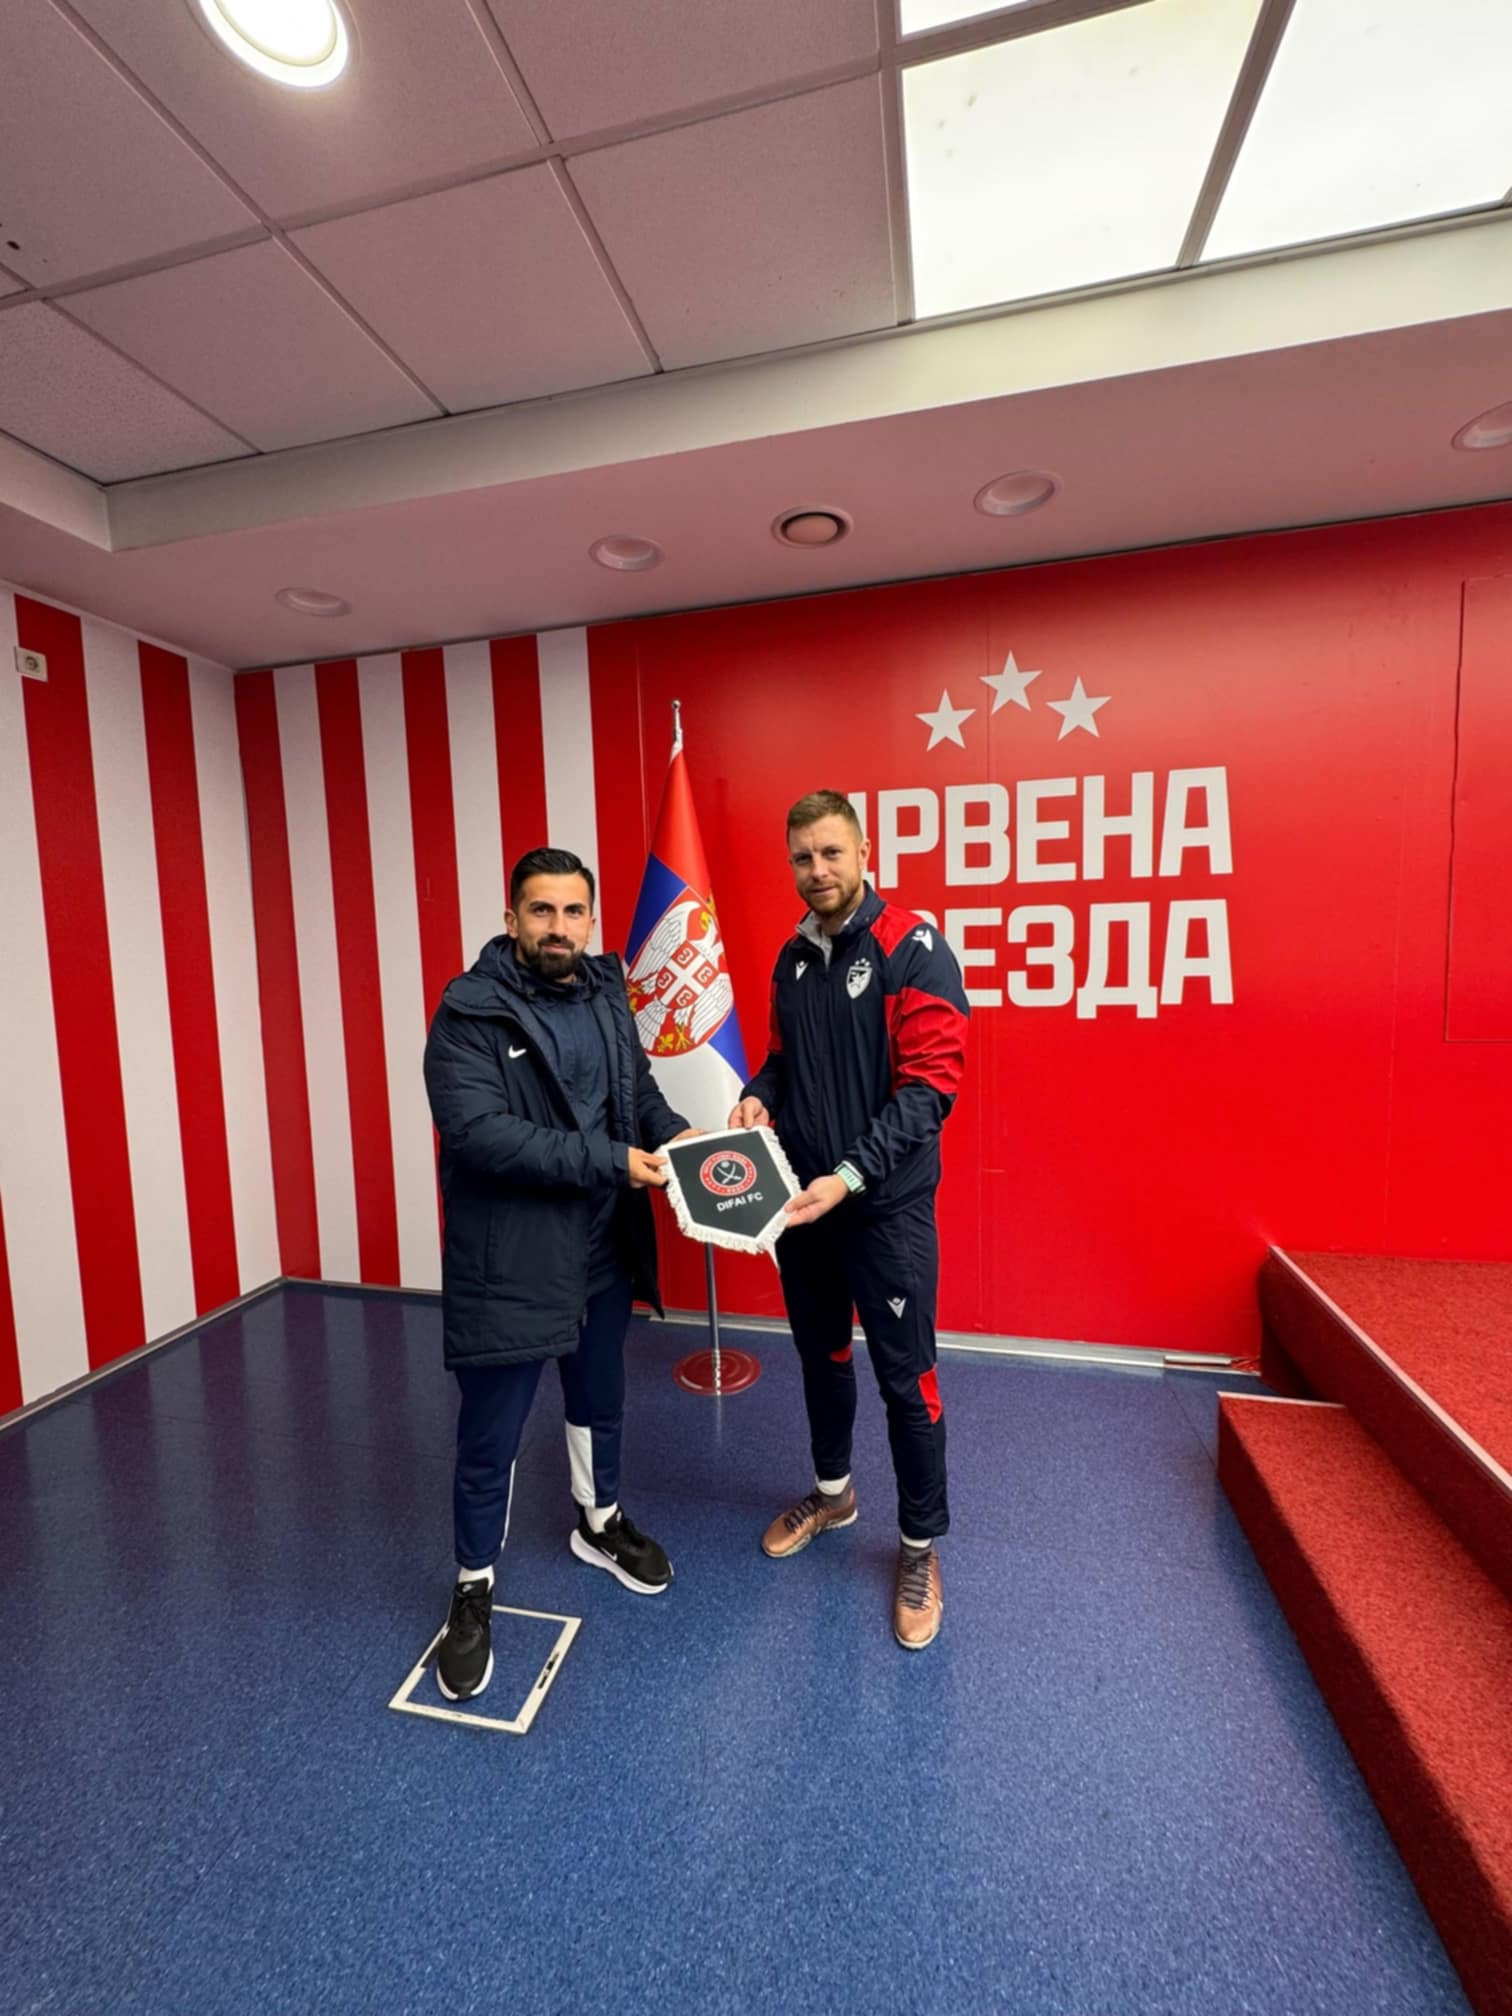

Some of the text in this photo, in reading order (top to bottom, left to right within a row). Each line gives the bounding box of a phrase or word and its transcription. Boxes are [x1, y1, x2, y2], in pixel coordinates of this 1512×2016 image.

[911, 898, 1234, 1020] ЕЗДА
[716, 1191, 764, 1212] DIFAI FC
